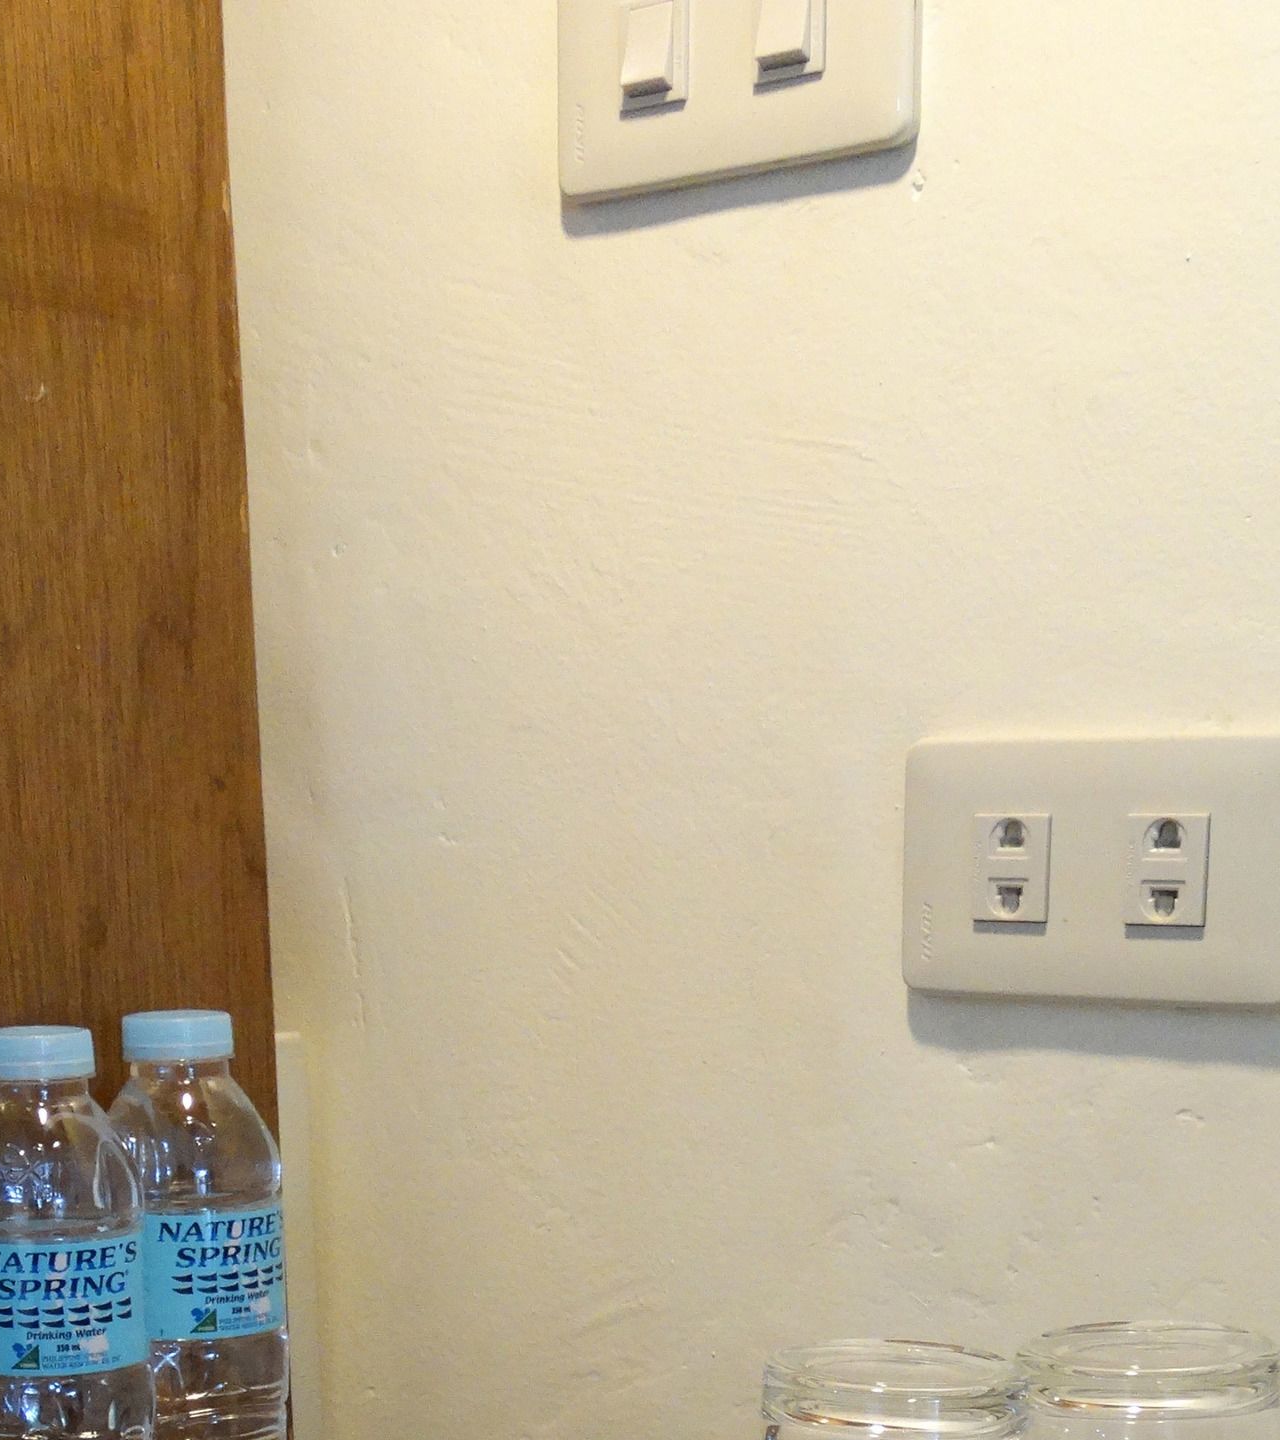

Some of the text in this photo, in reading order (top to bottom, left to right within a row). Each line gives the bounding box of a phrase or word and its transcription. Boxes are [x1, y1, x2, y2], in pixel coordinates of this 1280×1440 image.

[176, 1236, 282, 1269] SPRING
[26, 1328, 107, 1341] Drinking Water
